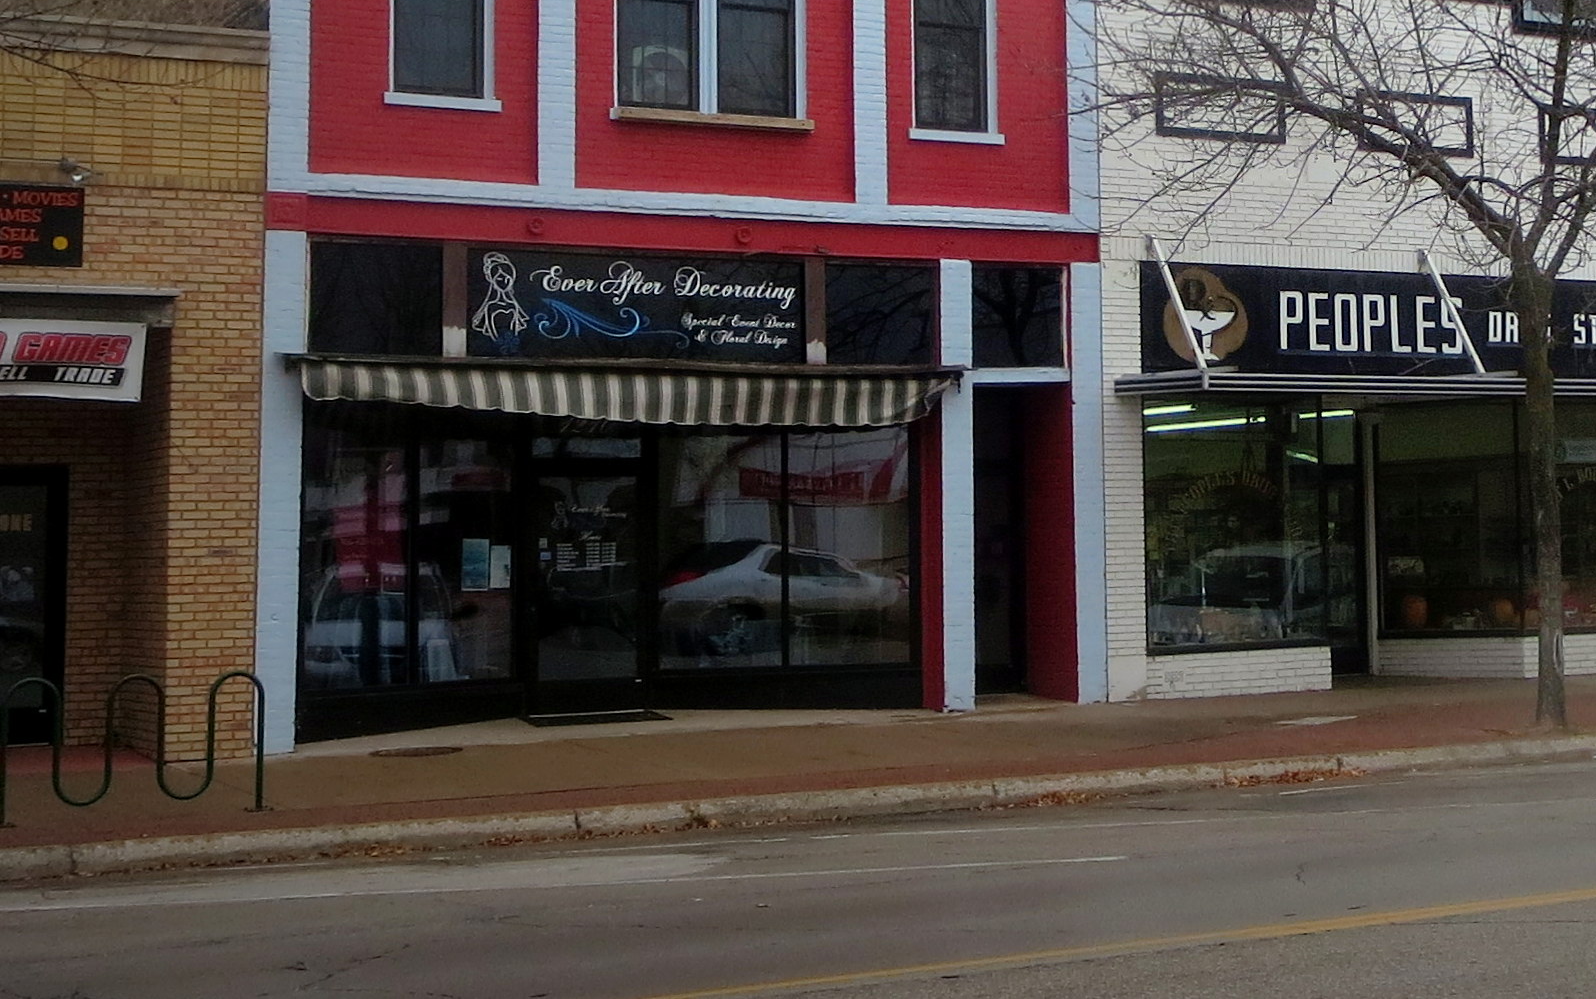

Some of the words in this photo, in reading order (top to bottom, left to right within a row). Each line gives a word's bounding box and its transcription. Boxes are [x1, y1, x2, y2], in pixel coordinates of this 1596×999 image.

[13, 190, 80, 207] MOVIES
[530, 264, 600, 294] Ever
[599, 260, 668, 306] After
[674, 265, 797, 310] Decorating
[1278, 289, 1464, 356] PEOPLES
[12, 331, 132, 365] GAMES
[53, 366, 116, 385] TRADE
